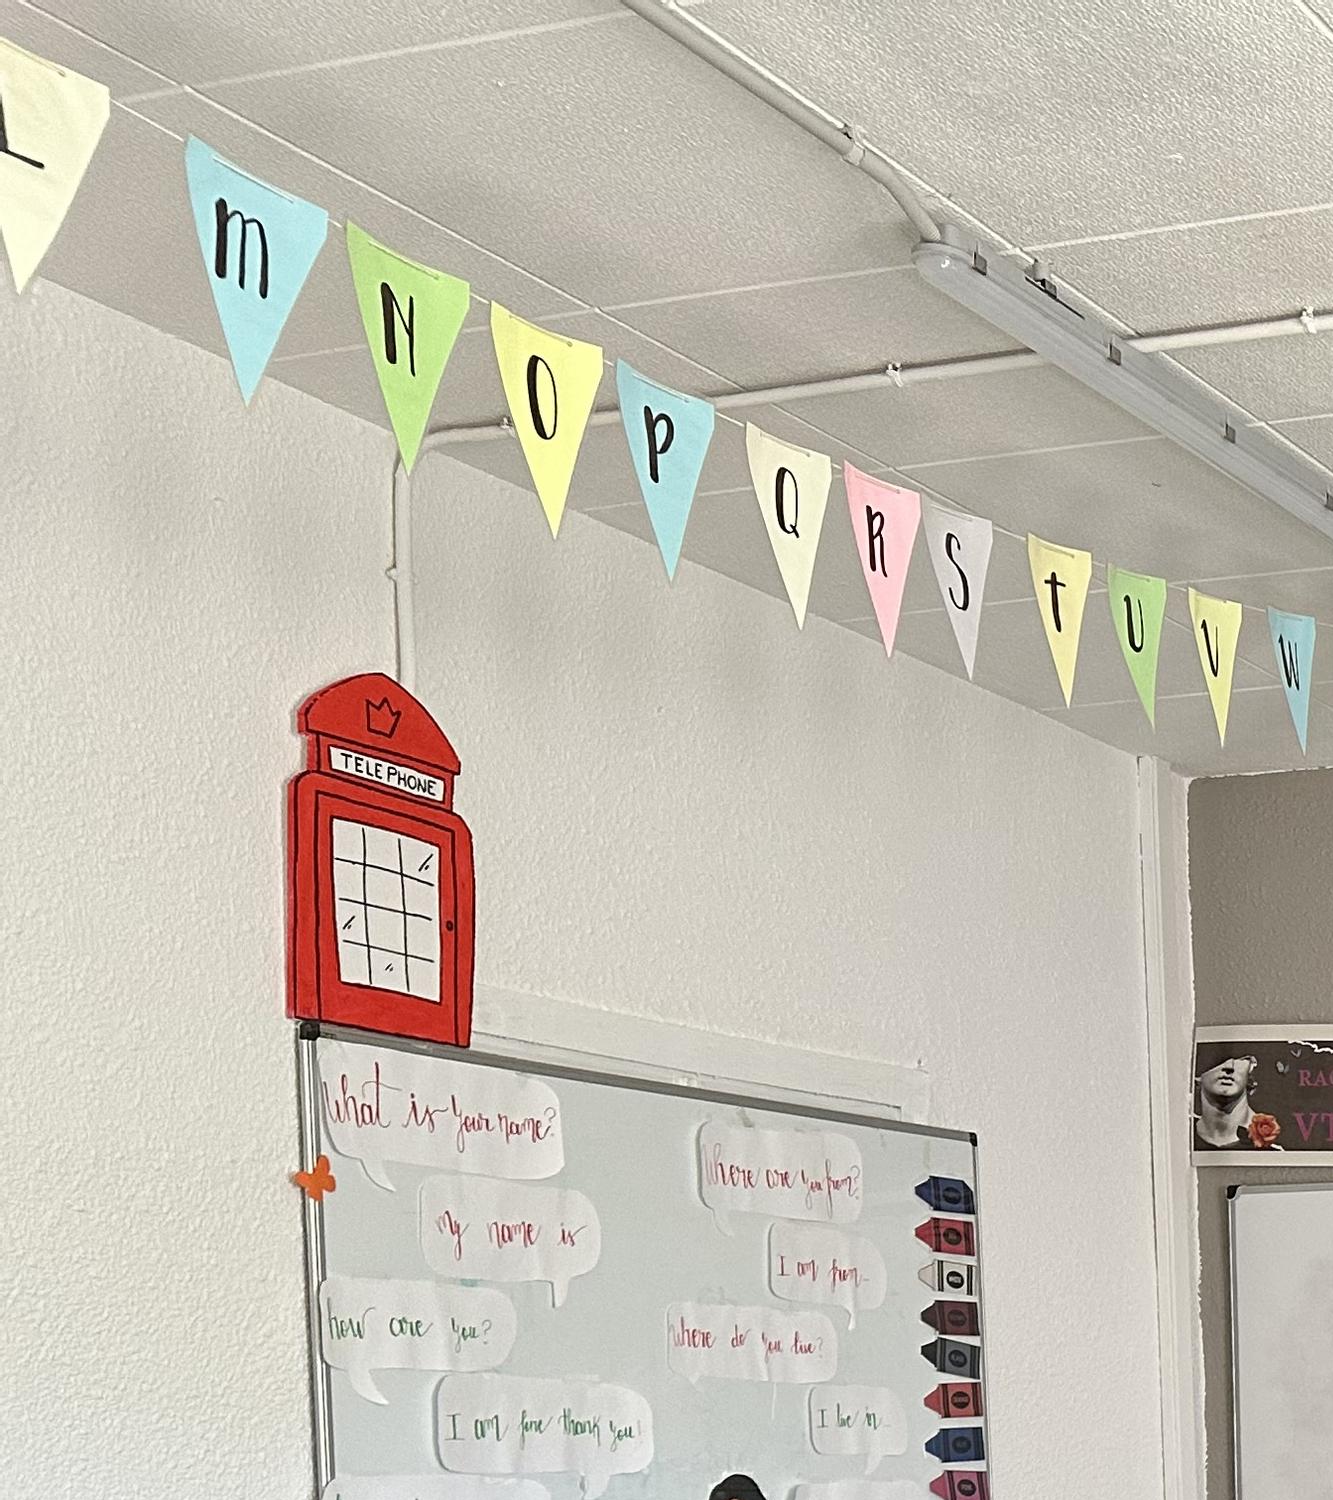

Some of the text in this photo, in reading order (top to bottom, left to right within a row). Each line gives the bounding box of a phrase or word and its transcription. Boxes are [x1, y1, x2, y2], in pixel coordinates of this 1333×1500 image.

[381, 281, 416, 376] N
[526, 354, 556, 440] O
[775, 466, 800, 538] Q
[865, 504, 888, 578] R
[945, 531, 969, 612] S
[1125, 594, 1144, 653] U
[1205, 618, 1221, 678] V
[1278, 634, 1300, 692] W
[402, 1093, 448, 1132] is
[766, 1169, 798, 1189] are
[488, 1222, 541, 1249] name
[558, 1223, 588, 1247] is
[777, 1256, 790, 1276] I
[797, 1260, 818, 1282] am
[389, 1315, 435, 1337] are
[450, 1317, 492, 1353] you?
[731, 1324, 751, 1348] do
[445, 1413, 465, 1441] I
[474, 1414, 508, 1442] am
[559, 1408, 600, 1446] thank
[817, 1408, 829, 1428] I
